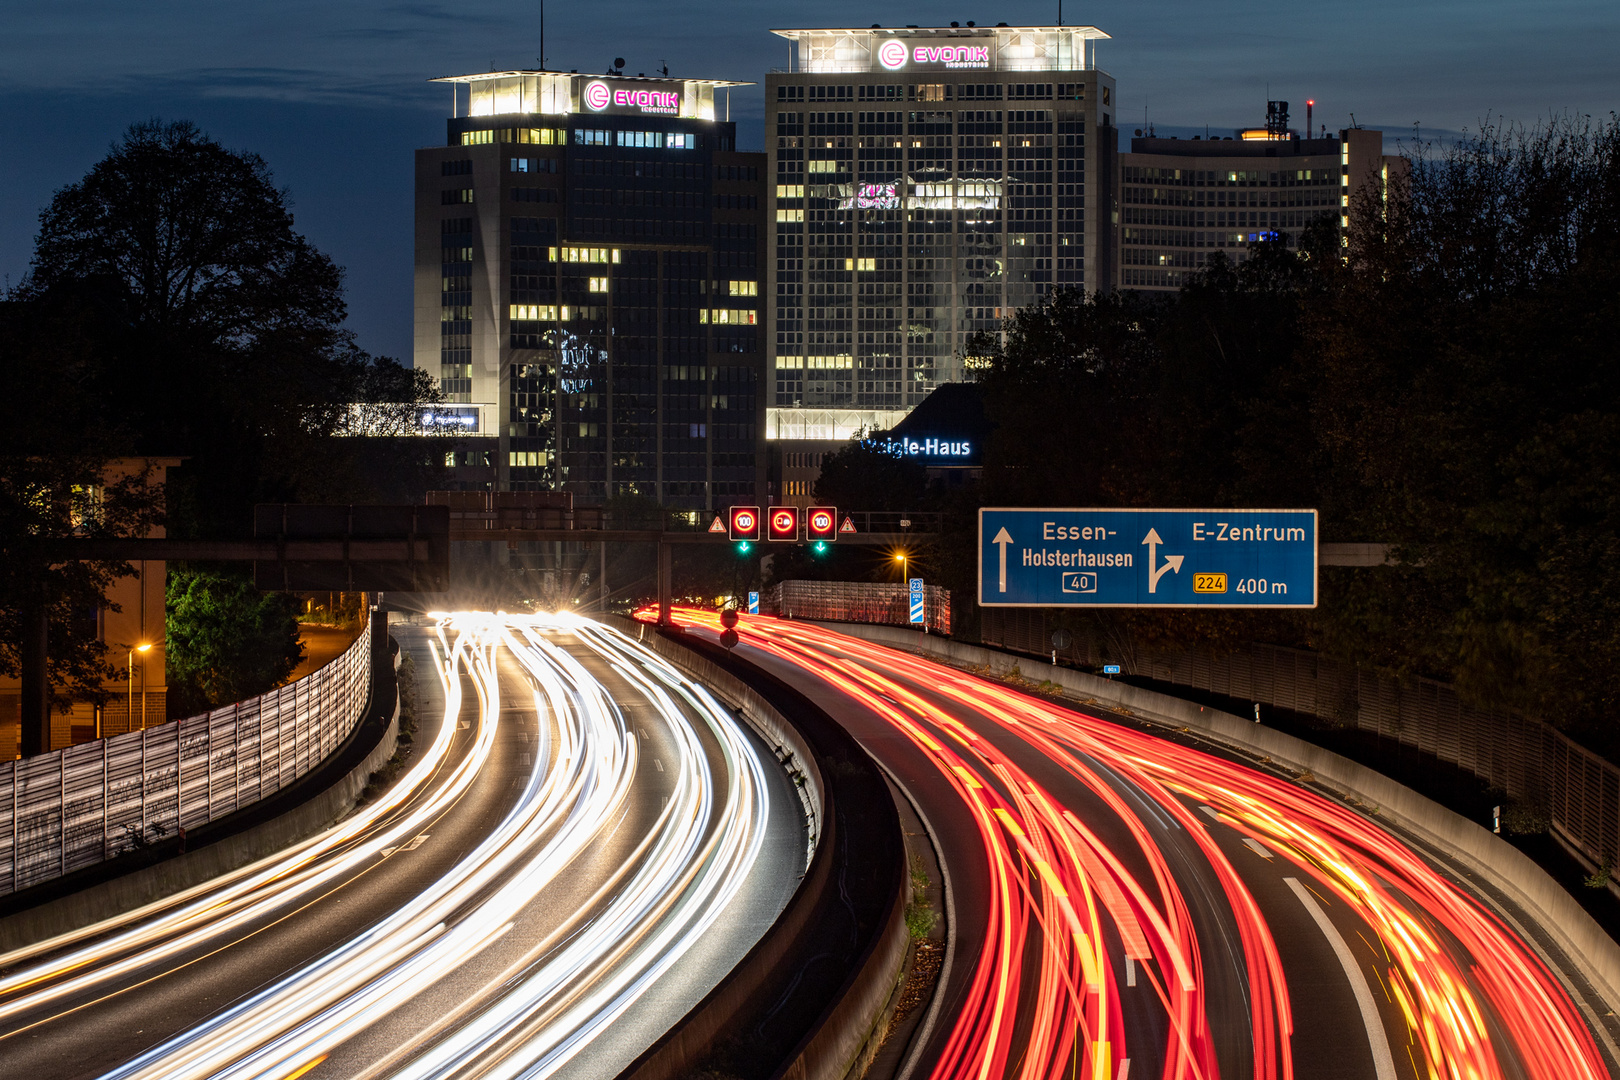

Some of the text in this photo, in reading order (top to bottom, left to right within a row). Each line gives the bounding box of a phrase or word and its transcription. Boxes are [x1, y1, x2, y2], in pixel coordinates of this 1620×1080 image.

[913, 46, 989, 62] EVONIK
[614, 90, 679, 108] EVONIK
[737, 516, 752, 527] 100
[814, 516, 829, 527] 100
[1043, 521, 1117, 541] Essen-
[1192, 522, 1306, 542] E-Zentrum
[1022, 547, 1133, 568] Holsterhausen
[1070, 576, 1089, 589] 40
[1197, 576, 1224, 590] 224
[1235, 578, 1288, 595] 400 m
